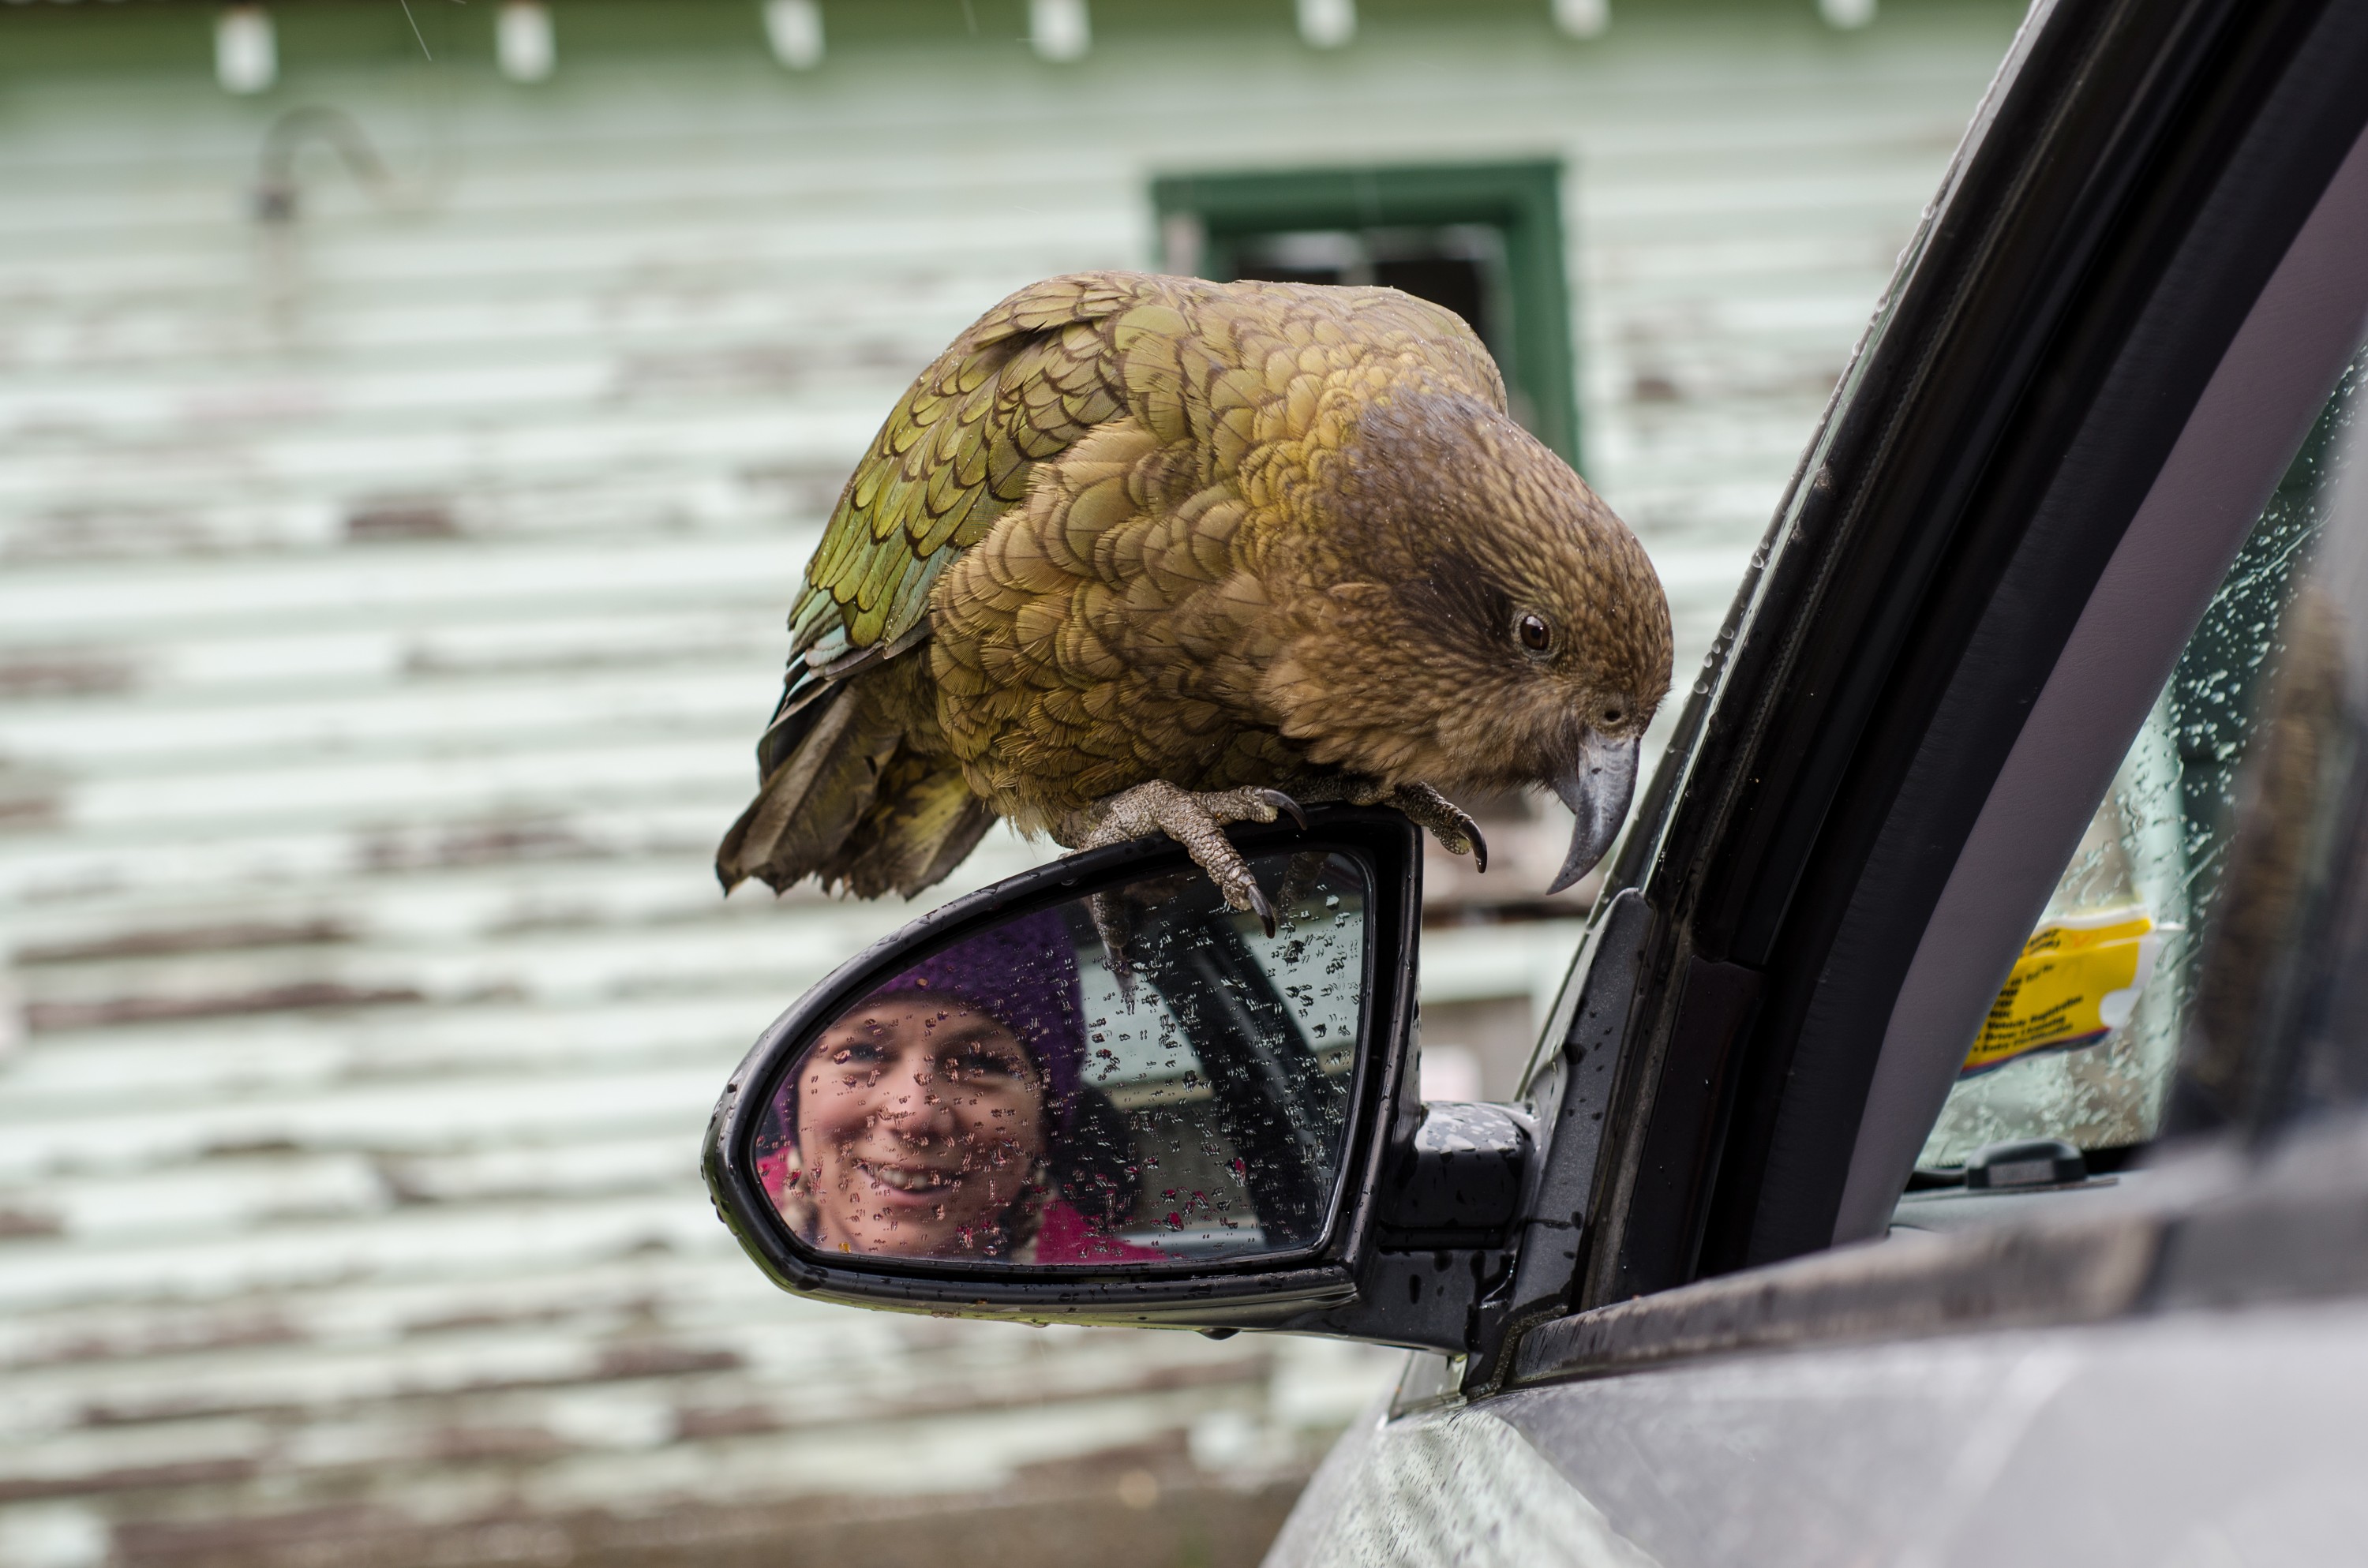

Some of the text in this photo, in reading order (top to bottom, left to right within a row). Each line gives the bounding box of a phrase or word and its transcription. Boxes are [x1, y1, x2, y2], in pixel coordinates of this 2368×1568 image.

[1987, 995, 2083, 1030] Vehicle Registration
[1985, 1015, 2066, 1042] Driver Licensing
